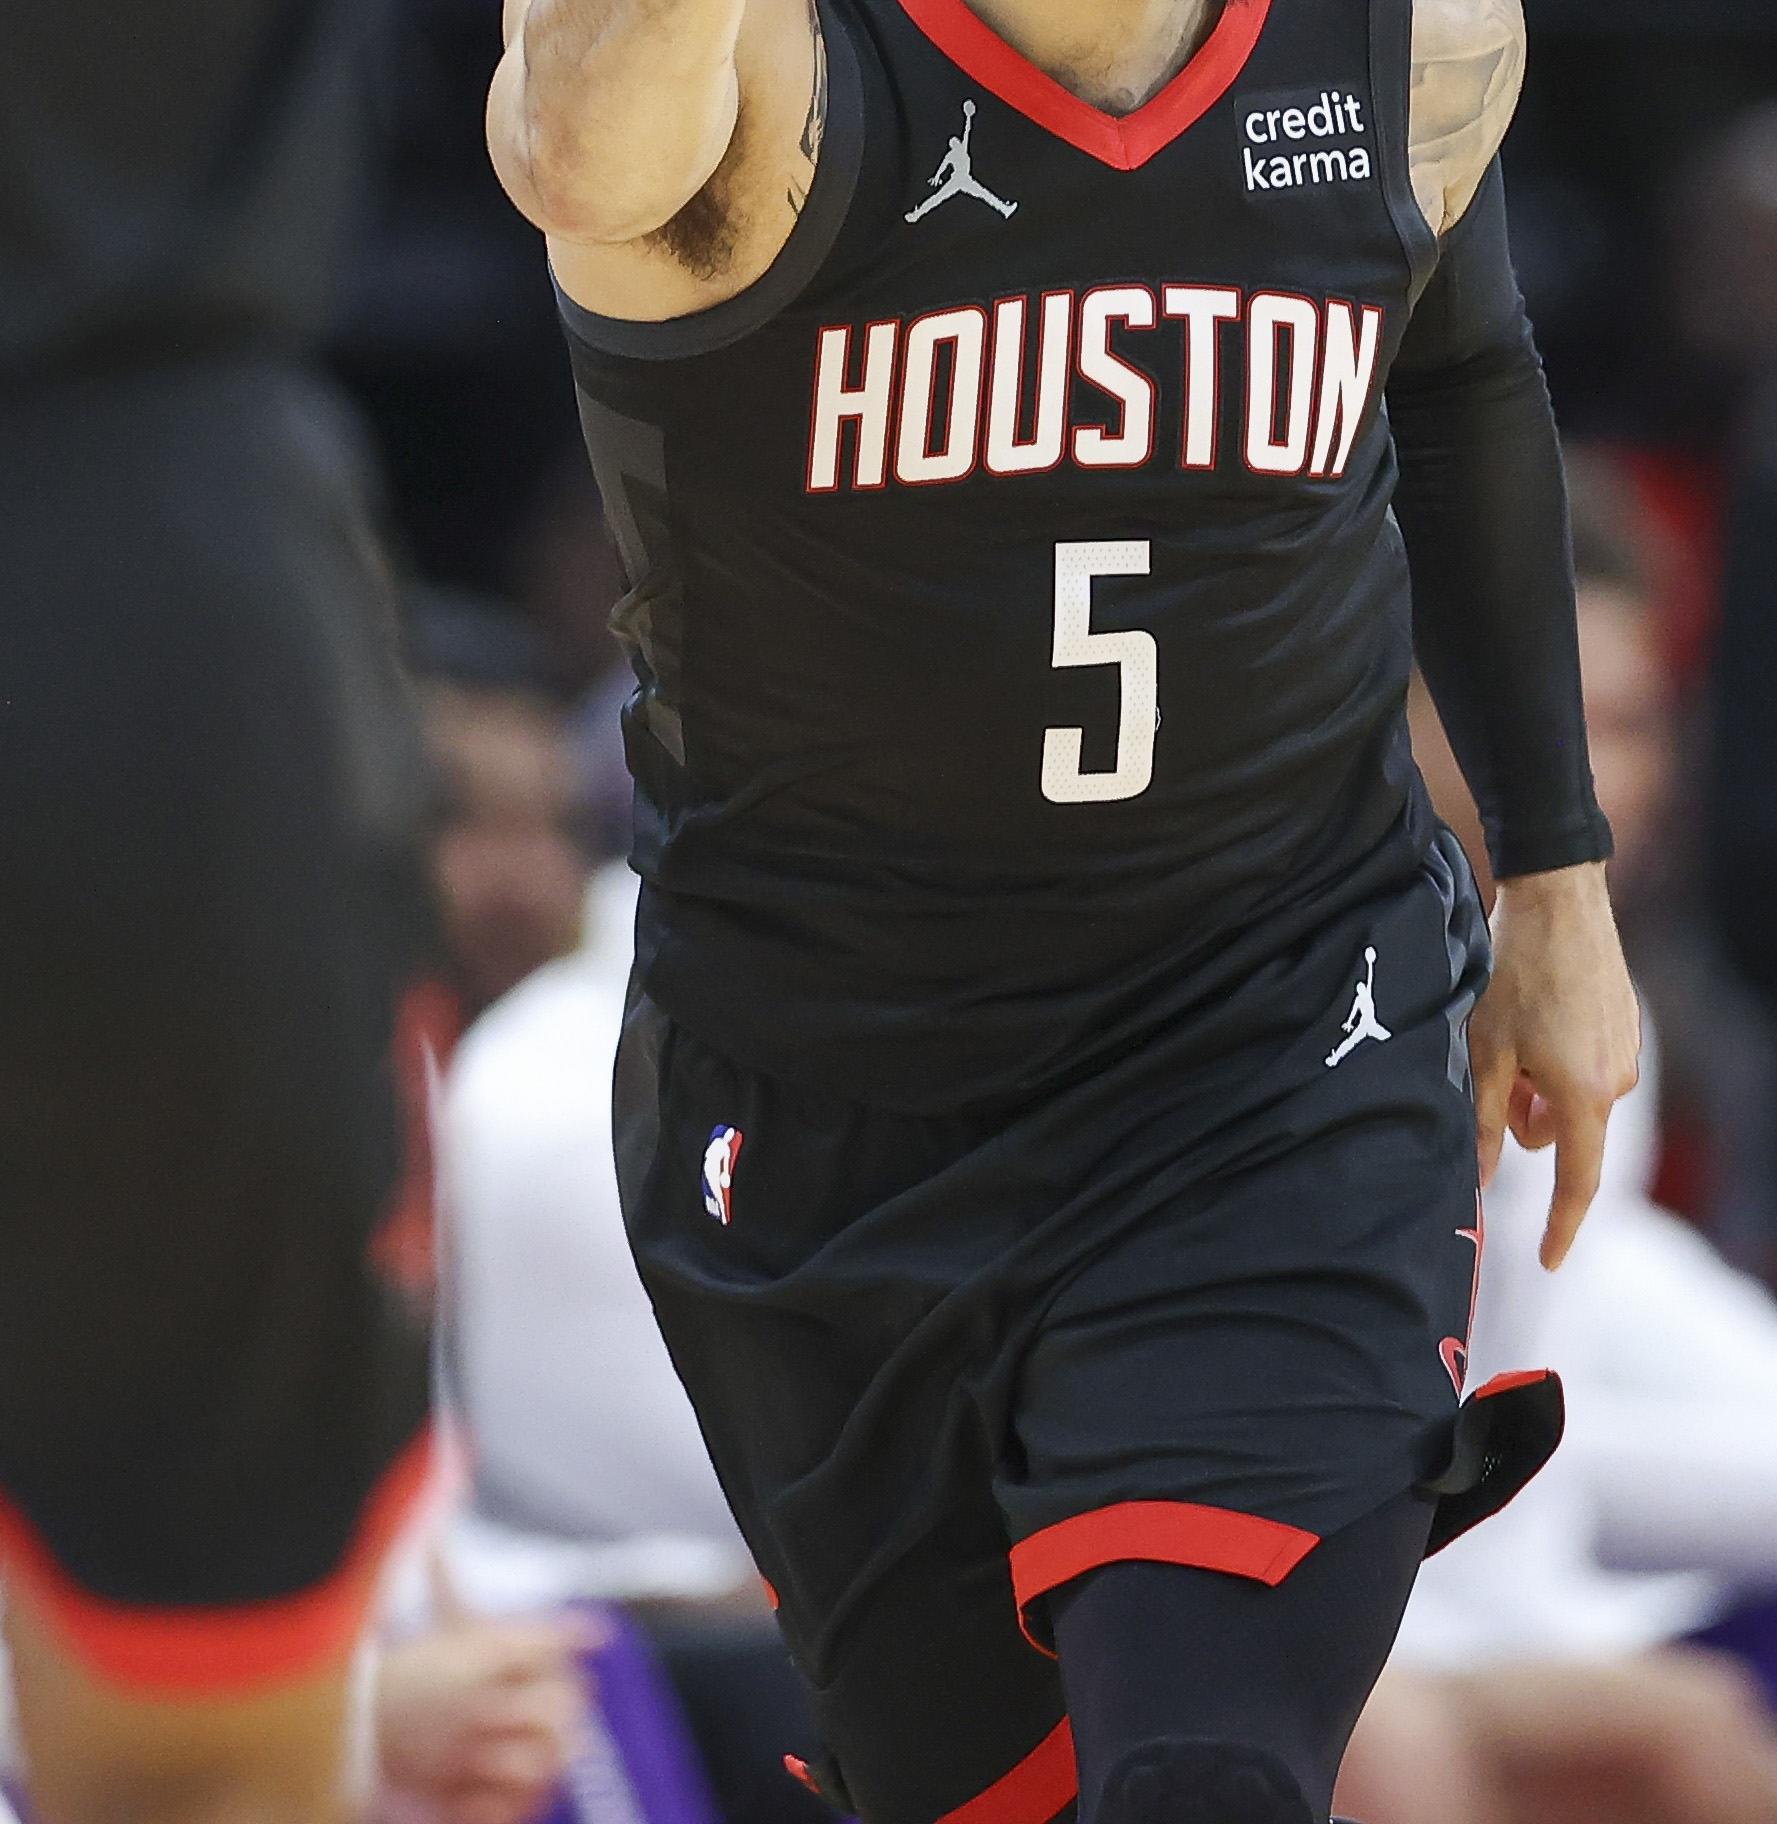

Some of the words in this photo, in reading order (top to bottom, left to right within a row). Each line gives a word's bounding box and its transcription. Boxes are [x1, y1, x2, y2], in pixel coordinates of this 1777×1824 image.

[1243, 147, 1371, 191] karma
[1245, 91, 1365, 143] credit
[806, 283, 1384, 494] HOUSTON
[1040, 539, 1159, 804] 5
